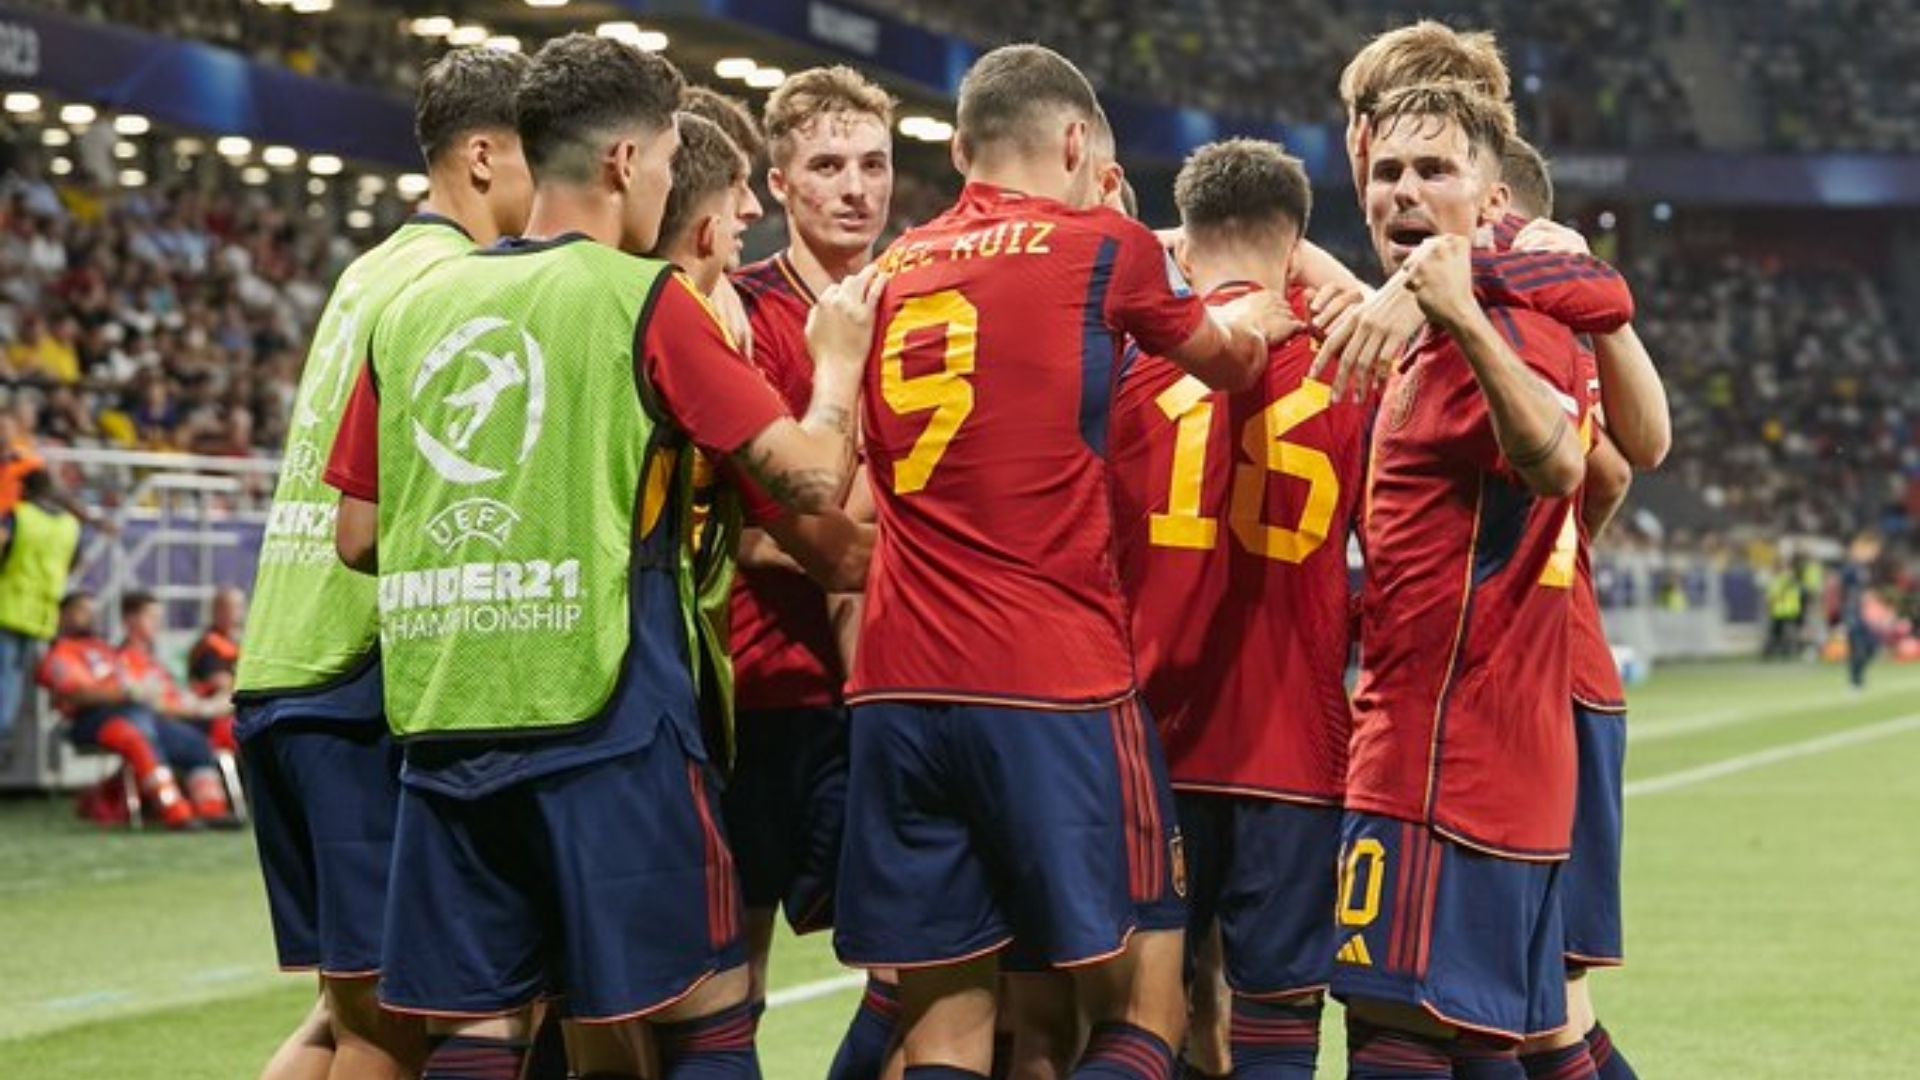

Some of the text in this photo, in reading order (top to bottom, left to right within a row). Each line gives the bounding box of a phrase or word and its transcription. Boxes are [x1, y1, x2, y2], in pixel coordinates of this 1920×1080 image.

[881, 290, 977, 493] 9
[1149, 376, 1339, 563] 16
[430, 506, 512, 545] UEFA
[379, 560, 579, 611] UNDER21
[1336, 838, 1386, 927] 0
